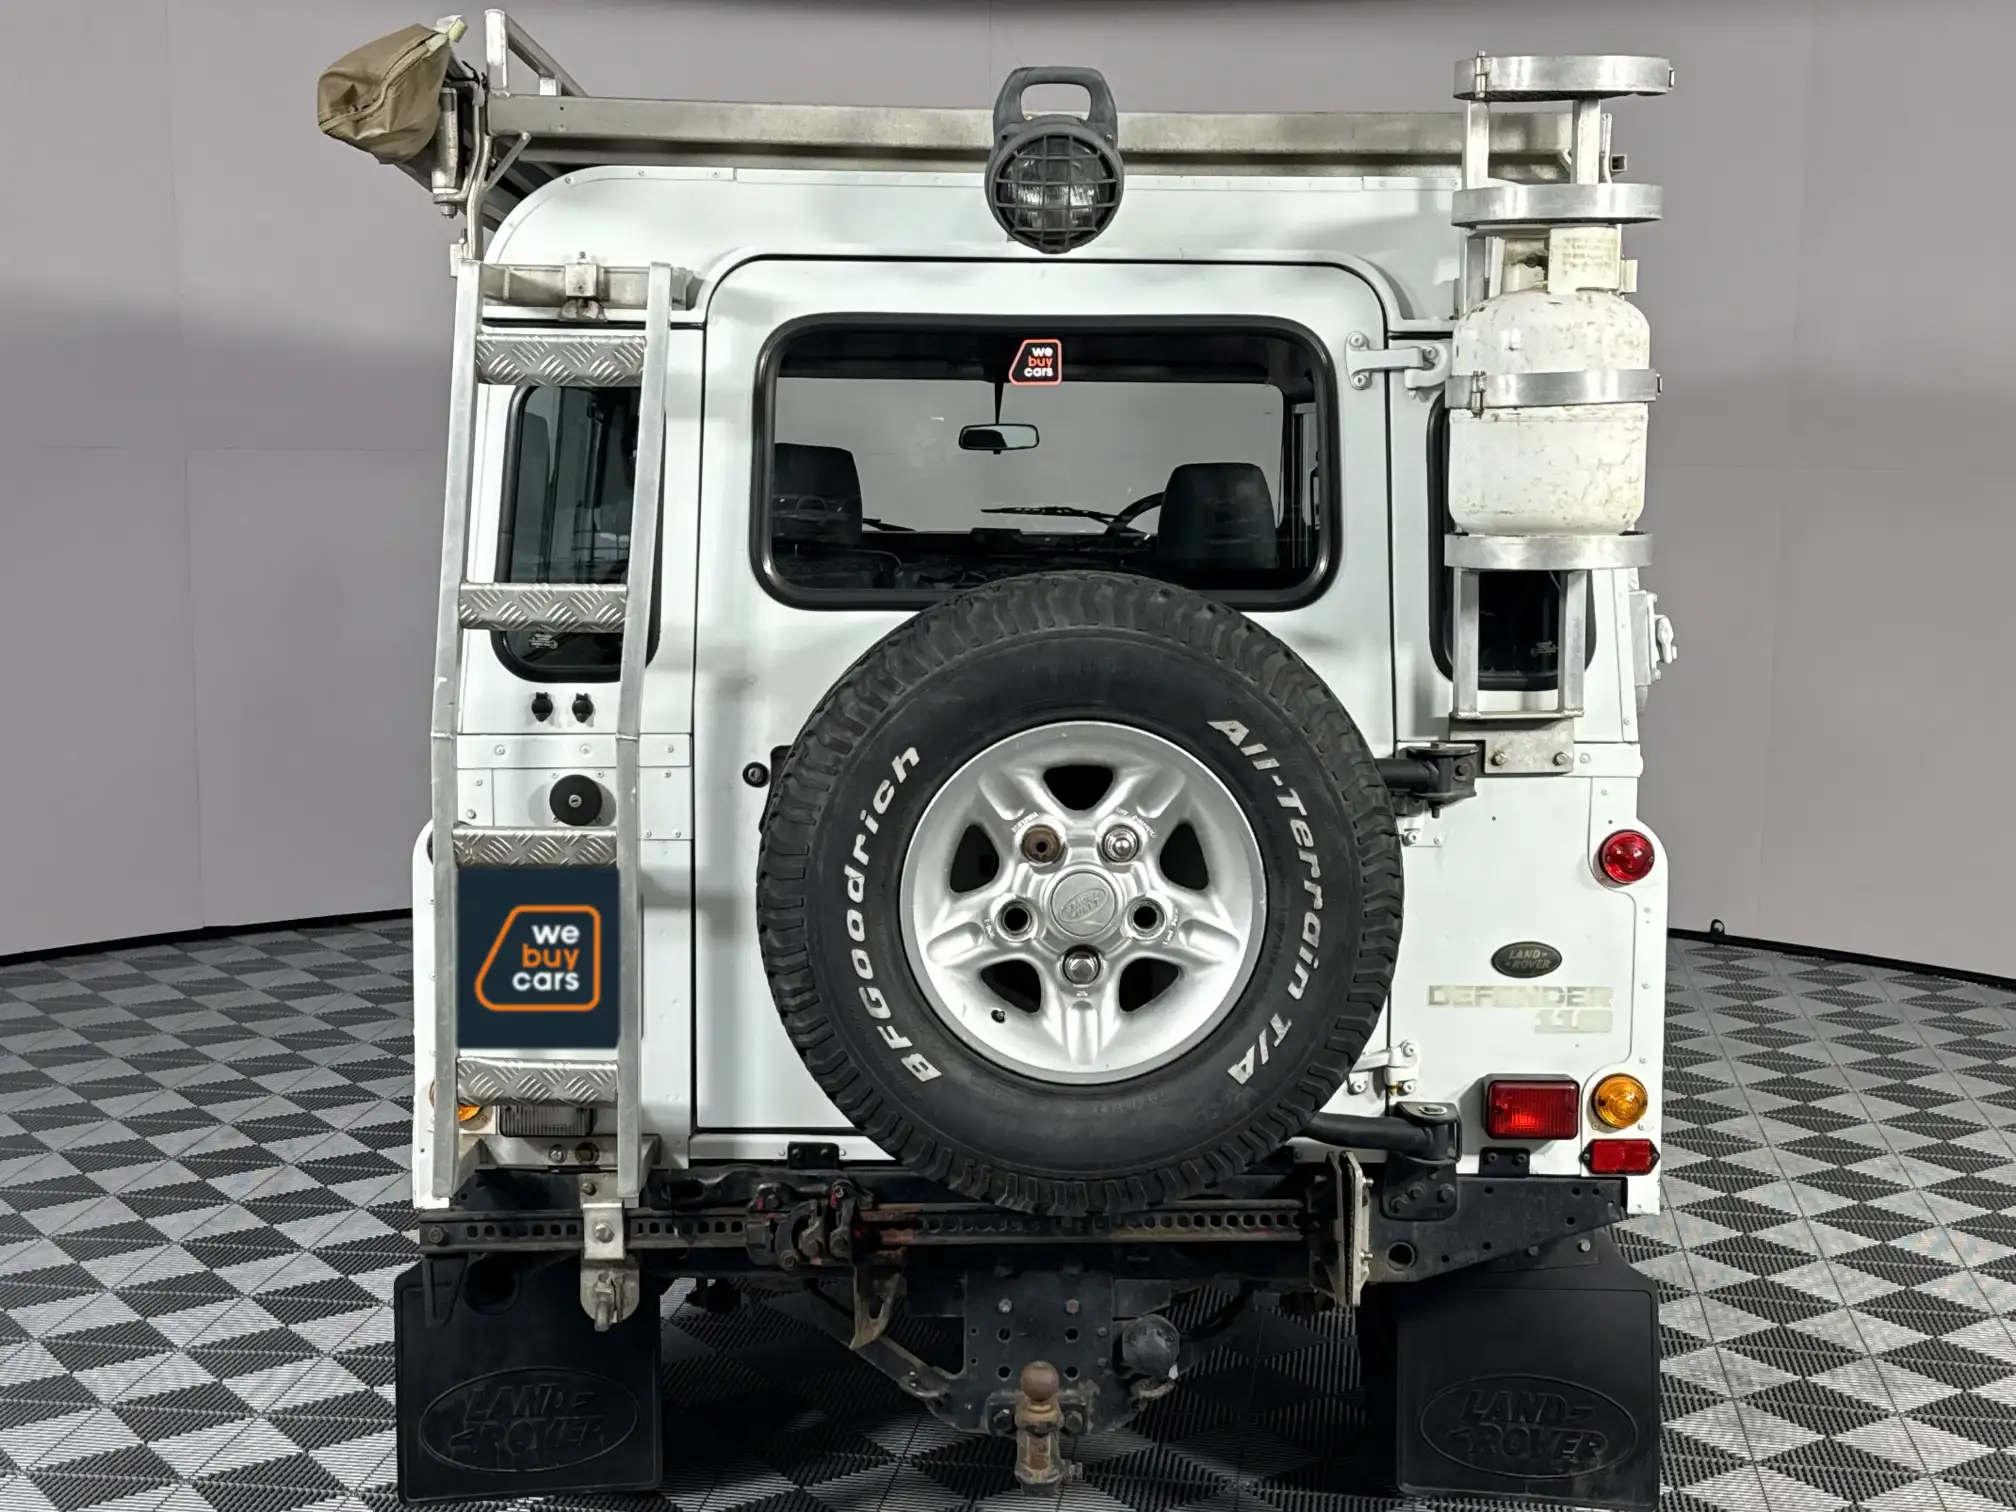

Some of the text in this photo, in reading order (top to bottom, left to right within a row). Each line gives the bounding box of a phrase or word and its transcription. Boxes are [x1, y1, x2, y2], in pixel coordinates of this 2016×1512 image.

[1028, 355, 1053, 368] buy
[1031, 347, 1053, 357] we
[1024, 367, 1054, 377] cars
[1207, 720, 1323, 1000] All-Terrain
[844, 747, 942, 1083] BFGoodrich
[1508, 949, 1541, 960] LAND
[1512, 960, 1551, 970] ROVER
[1534, 1009, 1613, 1034] 110
[1227, 1013, 1292, 1085] T/A
[463, 1383, 568, 1421] LAND
[1460, 1390, 1568, 1424] LAND
[1467, 1422, 1609, 1460] ROVER
